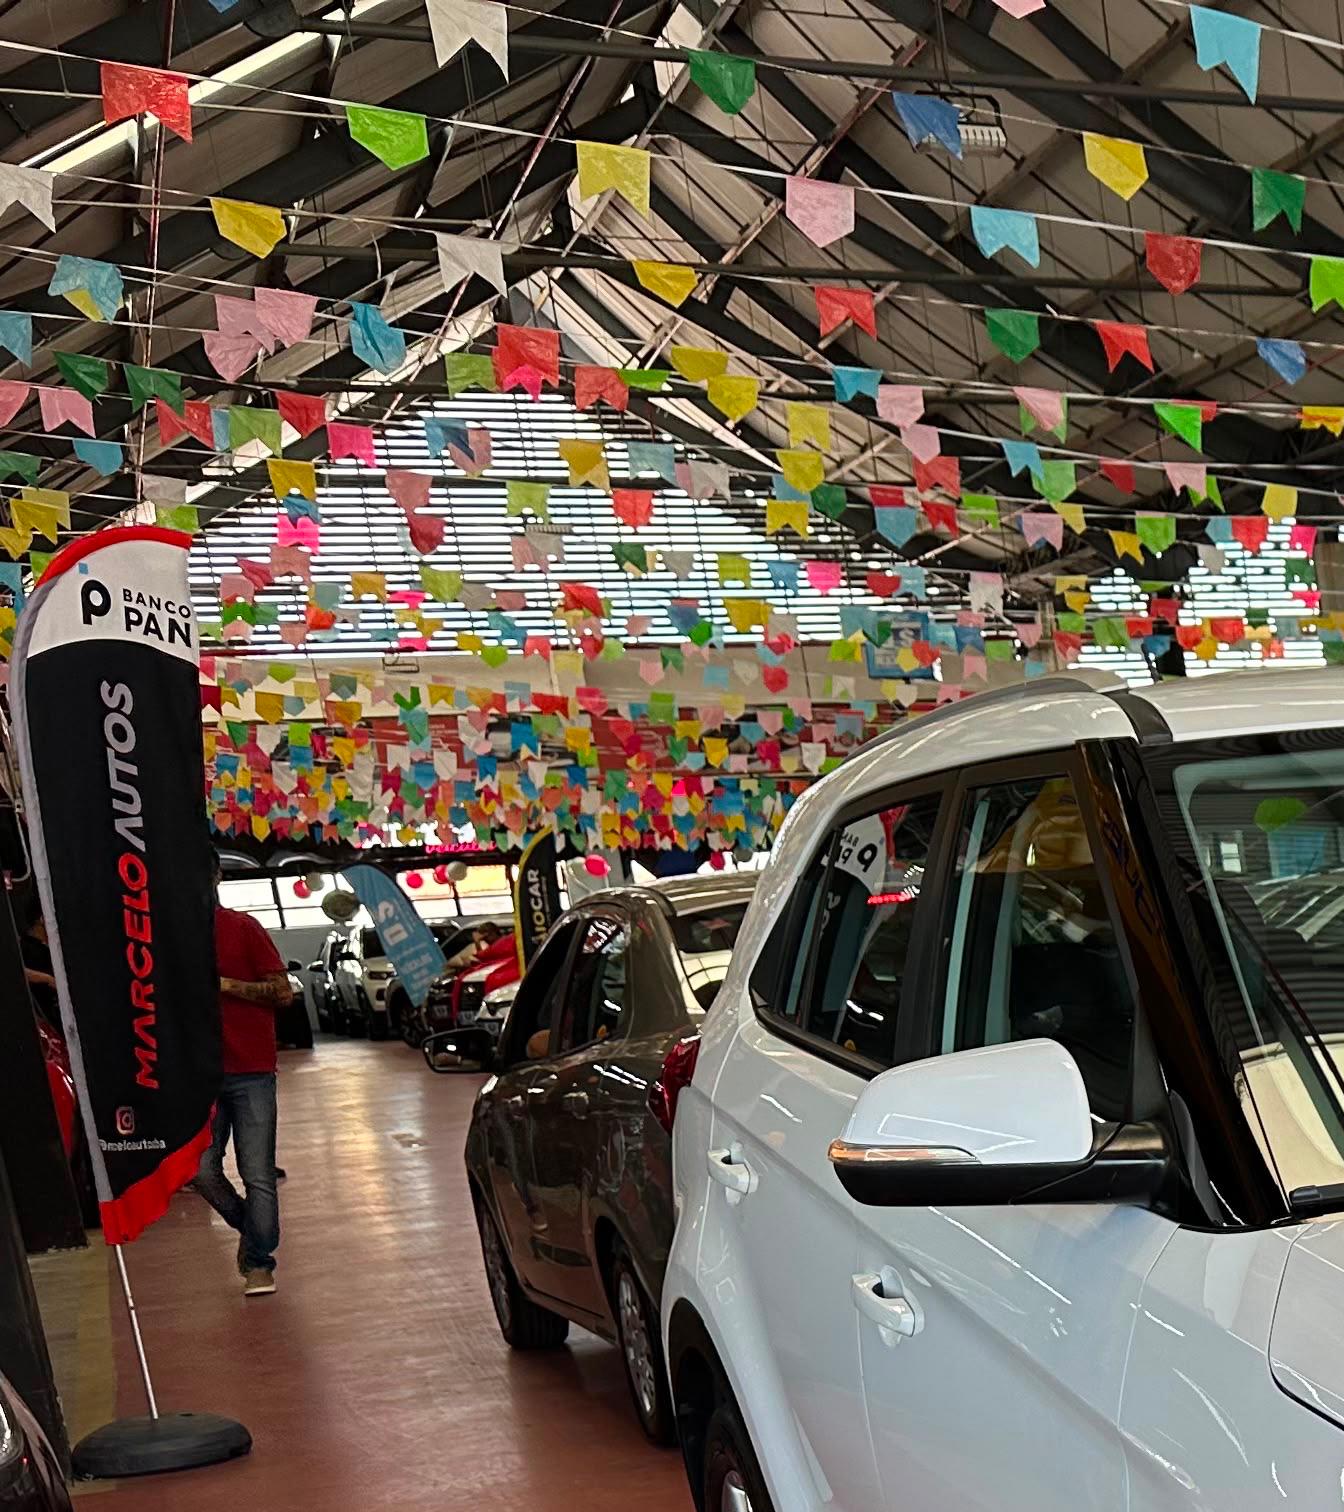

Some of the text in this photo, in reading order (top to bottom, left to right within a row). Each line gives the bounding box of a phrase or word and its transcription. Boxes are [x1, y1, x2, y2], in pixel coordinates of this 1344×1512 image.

[122, 588, 192, 619] BANCO
[123, 605, 193, 648] PAN
[100, 680, 160, 1089] MARCELO AUTOS
